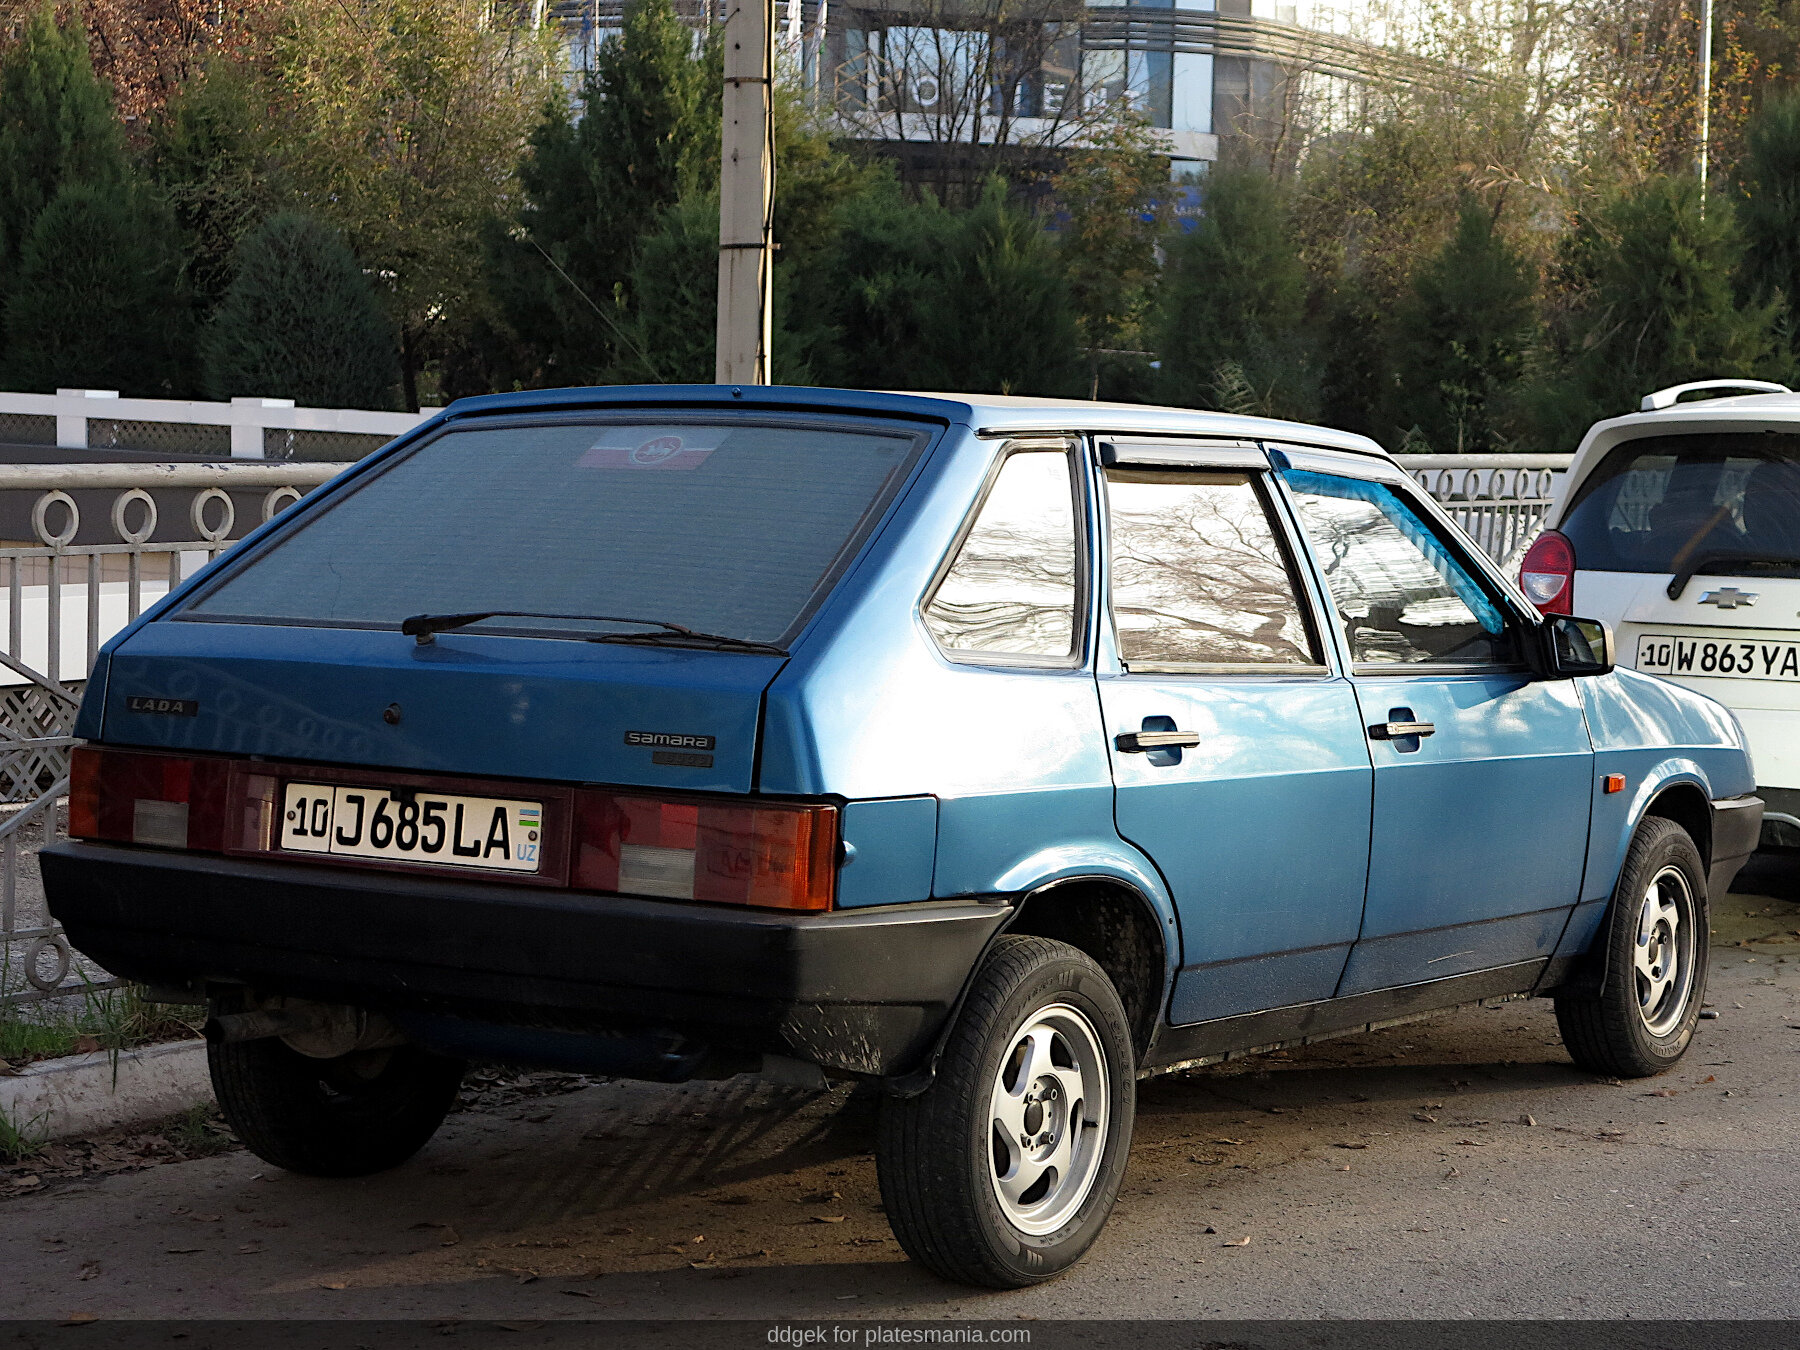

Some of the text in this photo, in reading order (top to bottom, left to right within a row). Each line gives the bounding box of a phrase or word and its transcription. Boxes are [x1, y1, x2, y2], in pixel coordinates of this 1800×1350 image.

[1643, 641, 1799, 677] 10 W863YA
[131, 698, 184, 713] LADA
[292, 794, 511, 860] 10 J685LA
[516, 843, 536, 862] UZ
